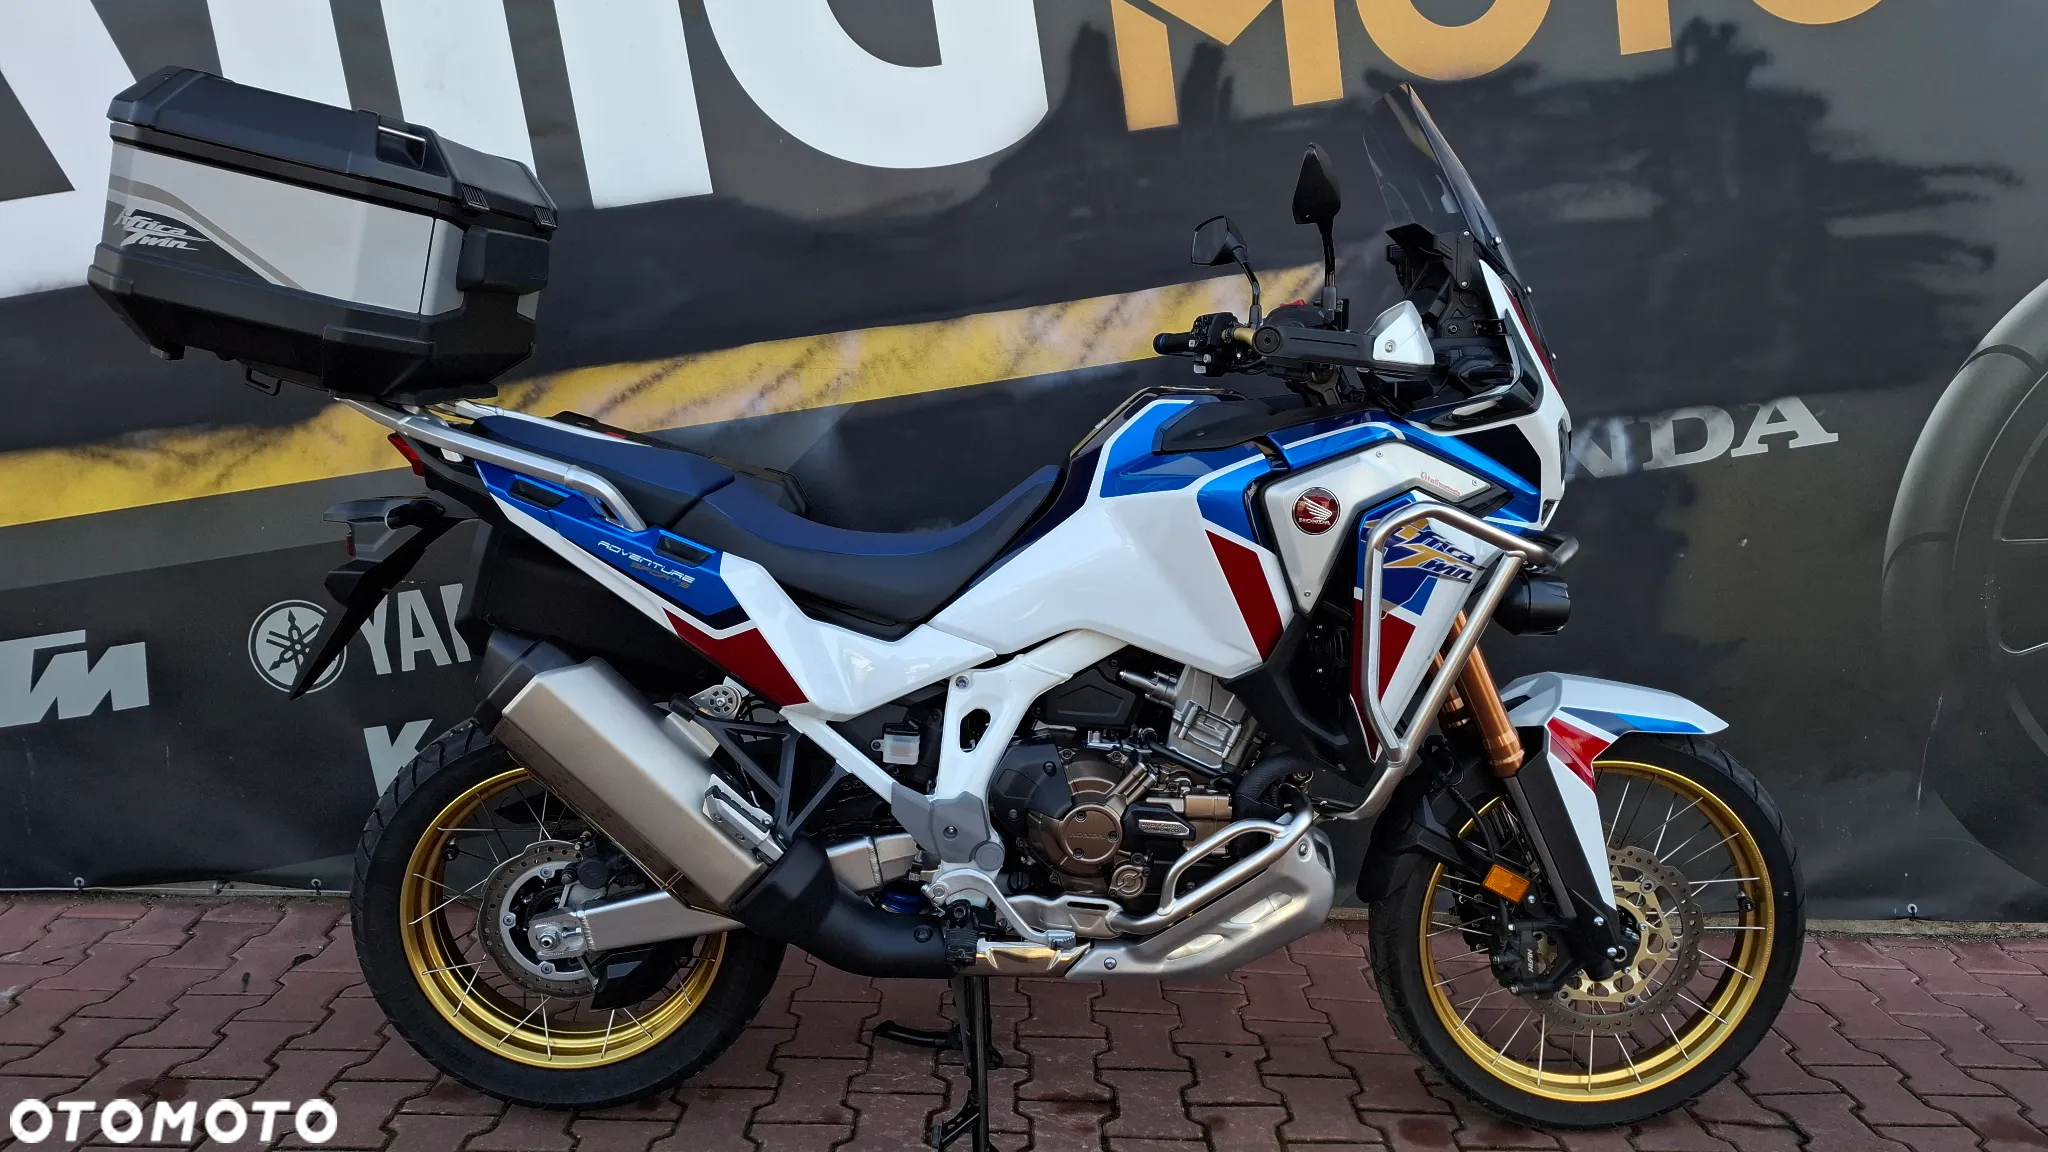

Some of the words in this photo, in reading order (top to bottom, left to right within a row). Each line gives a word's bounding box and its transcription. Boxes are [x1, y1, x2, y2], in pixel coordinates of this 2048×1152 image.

[120, 228, 211, 251] Twin
[1564, 396, 1839, 482] NDA
[1298, 517, 1331, 525] HONDA
[597, 540, 696, 584] ADVENTURE
[630, 561, 691, 589] SPORTS
[0, 629, 150, 728] TM
